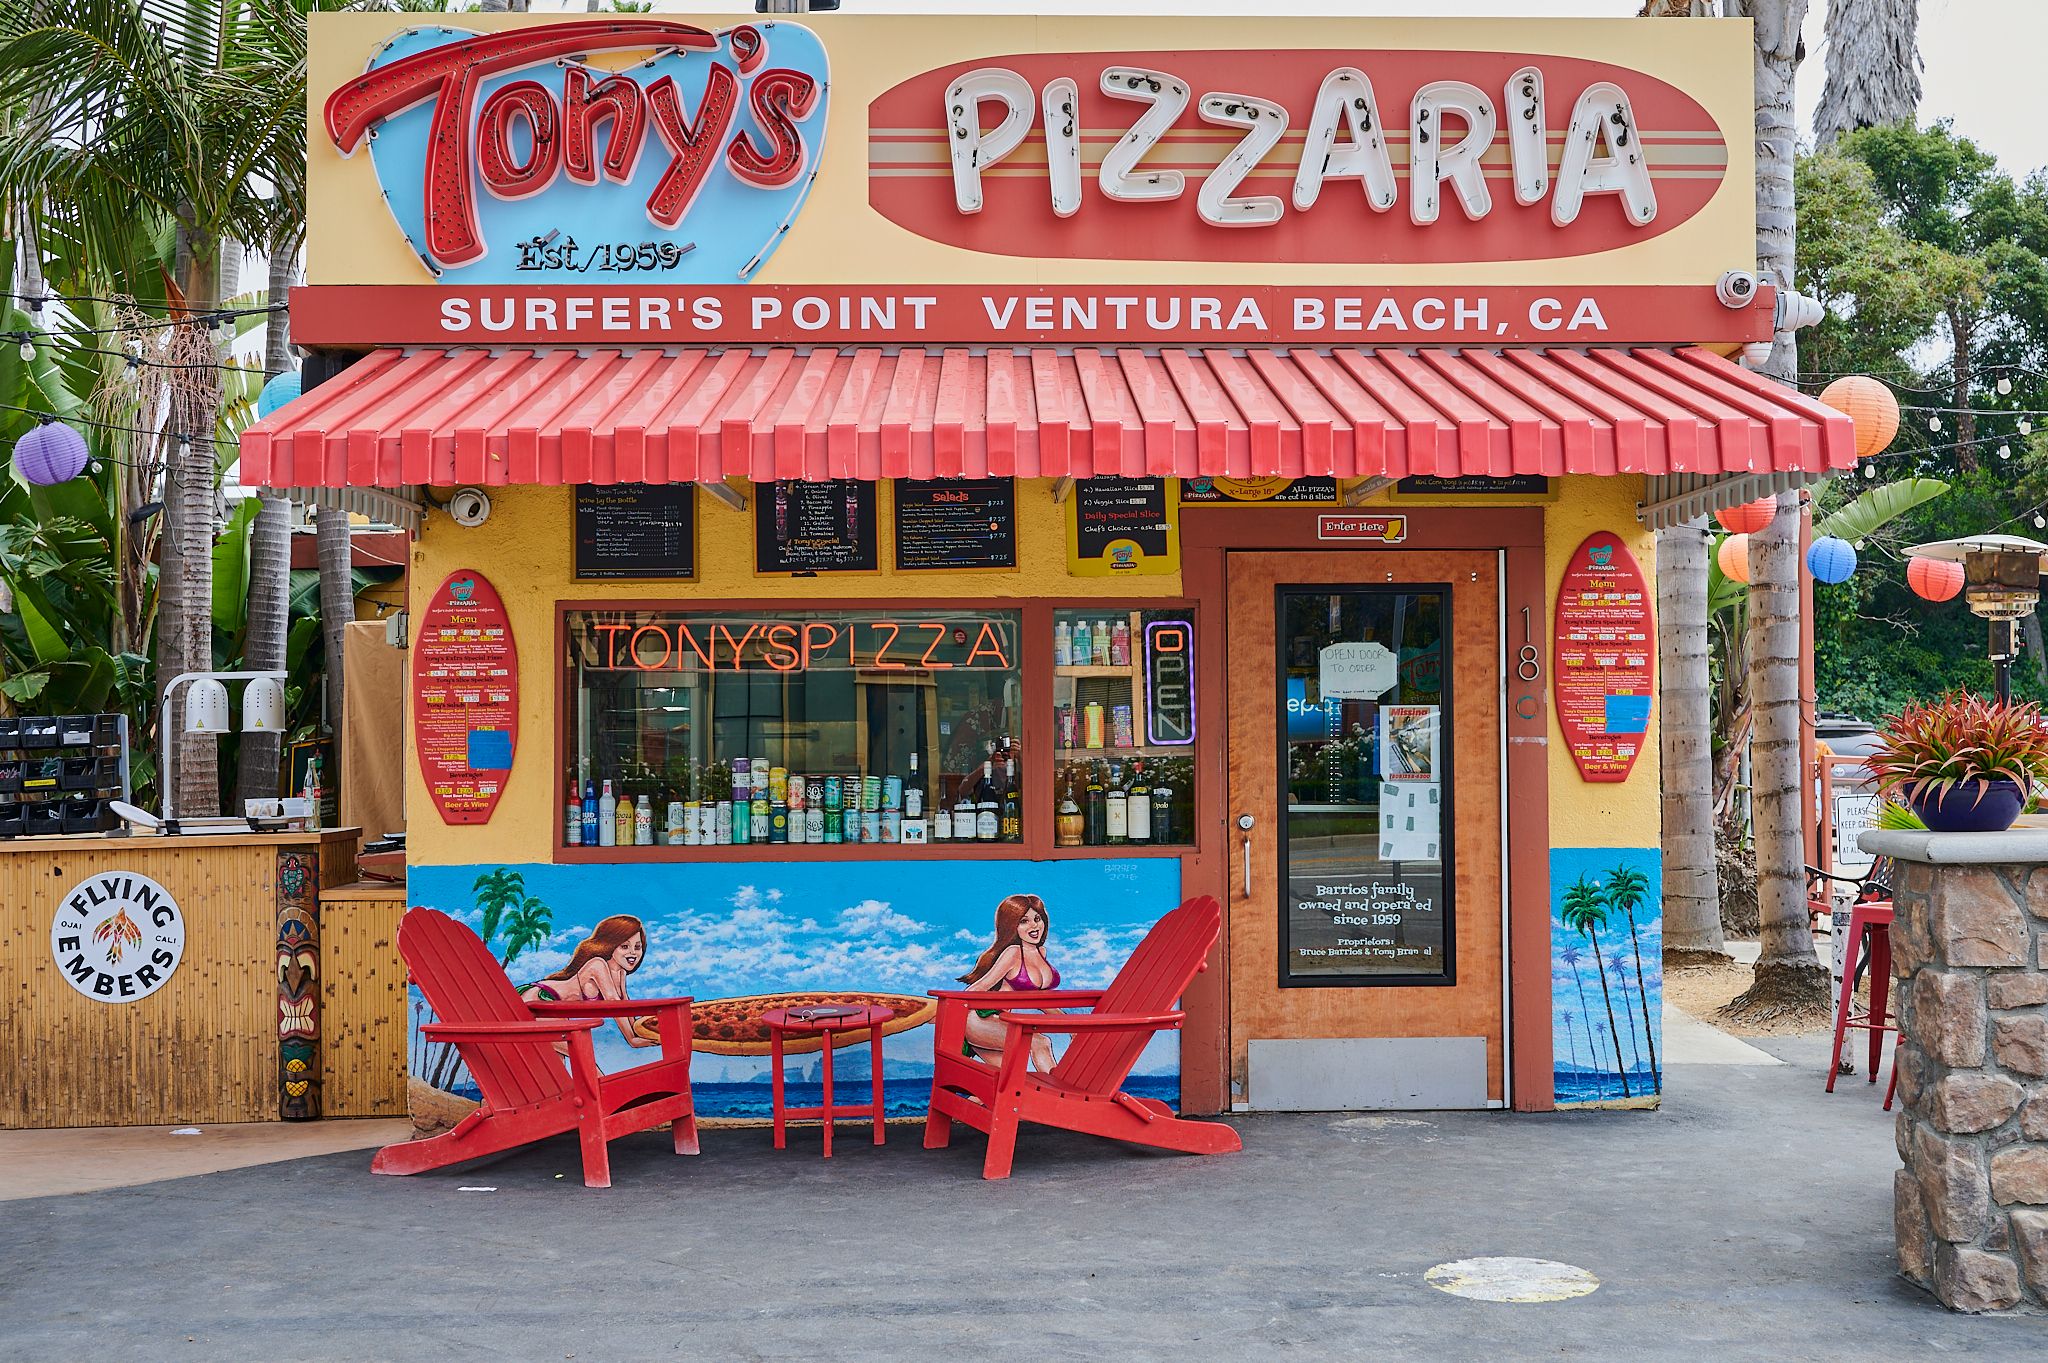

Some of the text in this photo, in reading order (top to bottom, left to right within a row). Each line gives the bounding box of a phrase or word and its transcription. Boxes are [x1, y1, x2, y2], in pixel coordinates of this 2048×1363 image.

[324, 20, 817, 266] Tony's
[943, 66, 1658, 229] PIZZARIA
[440, 297, 1608, 335] SURFER'S POINT VENTURA BEACH, CA
[1085, 509, 1160, 522] Daily Special Slice
[1084, 525, 1106, 534] Chef's
[1325, 521, 1385, 532] Enter Here
[1590, 580, 1616, 588] Menu
[451, 615, 477, 624] Menu
[594, 622, 1009, 671] TONY'S PIZZA
[1325, 648, 1387, 660] OPEN DOOR
[1330, 664, 1377, 673] TO ORDER
[1156, 630, 1186, 738] OPEN
[1391, 708, 1428, 716] Missing
[806, 786, 824, 799] 805
[806, 820, 824, 832] 805
[1841, 821, 1856, 829] KEEP
[1316, 881, 1415, 900] Barrios family
[69, 877, 175, 928] FLYING
[1299, 897, 1433, 912] owned and operaed
[1333, 913, 1401, 925] since 1959
[61, 921, 82, 930] OJAI
[155, 935, 176, 944] CALI
[1337, 936, 1394, 947] Proprietors:
[1300, 948, 1326, 956] Bruce
[1328, 948, 1362, 956] Barrios
[1372, 948, 1395, 959] Tony
[58, 935, 174, 997] EMBERS
